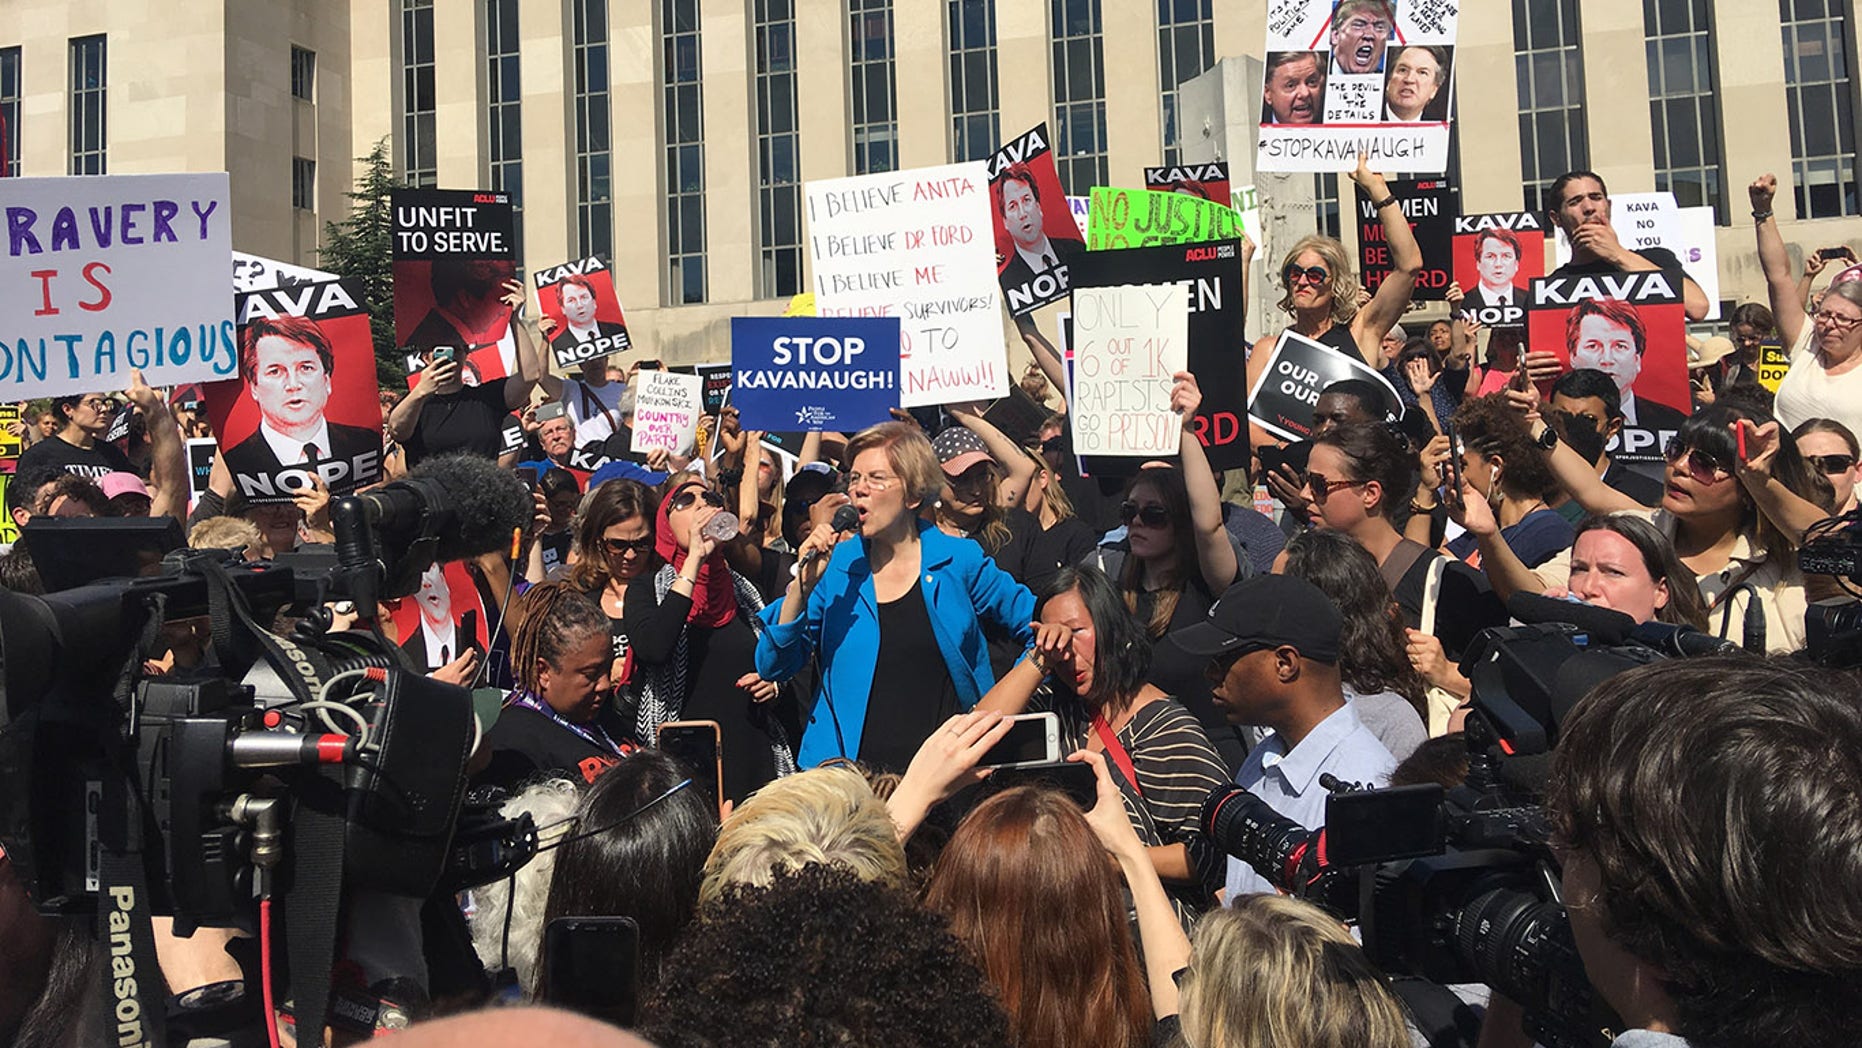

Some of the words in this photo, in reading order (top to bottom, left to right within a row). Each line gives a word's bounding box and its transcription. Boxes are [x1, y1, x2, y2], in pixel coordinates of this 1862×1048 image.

[1329, 83, 1346, 91] THE
[1352, 83, 1380, 91] DEVIL
[1354, 92, 1365, 100] IN
[1346, 100, 1366, 108] THE
[1327, 110, 1375, 120] DETAILS
[1147, 165, 1225, 184] KAVA
[809, 195, 816, 222] I
[826, 182, 905, 218] BELIEVE
[913, 177, 976, 201] ANITA
[1362, 197, 1438, 218] WMEN
[1626, 202, 1660, 213] KAVA
[398, 206, 477, 228] UNFIT
[1092, 191, 1130, 230] NO
[1364, 222, 1418, 242] MUT
[1456, 213, 1540, 233] KAVA
[1636, 219, 1655, 230] NO
[397, 232, 428, 252] TO
[433, 231, 509, 253] SERVE.
[813, 235, 820, 260] I
[827, 231, 897, 258] BELIEVE
[905, 229, 925, 250] DR
[932, 224, 974, 247] FORD
[1635, 236, 1662, 247] YOU
[1185, 246, 1217, 262] ACLU
[1365, 248, 1388, 266] BE
[536, 256, 605, 288] KAVA
[818, 274, 826, 296] I
[832, 269, 904, 294] BELIEVE
[915, 264, 946, 286] ME
[1366, 269, 1448, 288] HRD
[30, 261, 112, 317] IS
[1535, 272, 1677, 305] KAVA
[903, 293, 993, 319] SURVIVORS!
[1076, 291, 1174, 332] ONLY
[556, 332, 629, 364] NOPE
[920, 326, 959, 353] TO
[1107, 337, 1136, 355] OUT
[773, 336, 865, 366] STOP
[1080, 340, 1101, 378] 6
[1142, 337, 1171, 378] 1K
[1110, 358, 1131, 376] OF
[1278, 360, 1319, 387] OUR
[653, 373, 681, 386] FLAKE
[737, 370, 895, 390] KAVANAUGH!
[646, 384, 688, 398] COLLINS
[1077, 379, 1173, 413] RAPISTS
[1280, 381, 1320, 407] OUR
[636, 408, 690, 428] COUNTRY
[648, 423, 673, 434] OVER
[1077, 413, 1101, 432] GO
[637, 429, 678, 451] PARTY
[1079, 432, 1101, 451] TO
[1108, 413, 1177, 452] PRISON
[236, 450, 378, 498] NOPE
